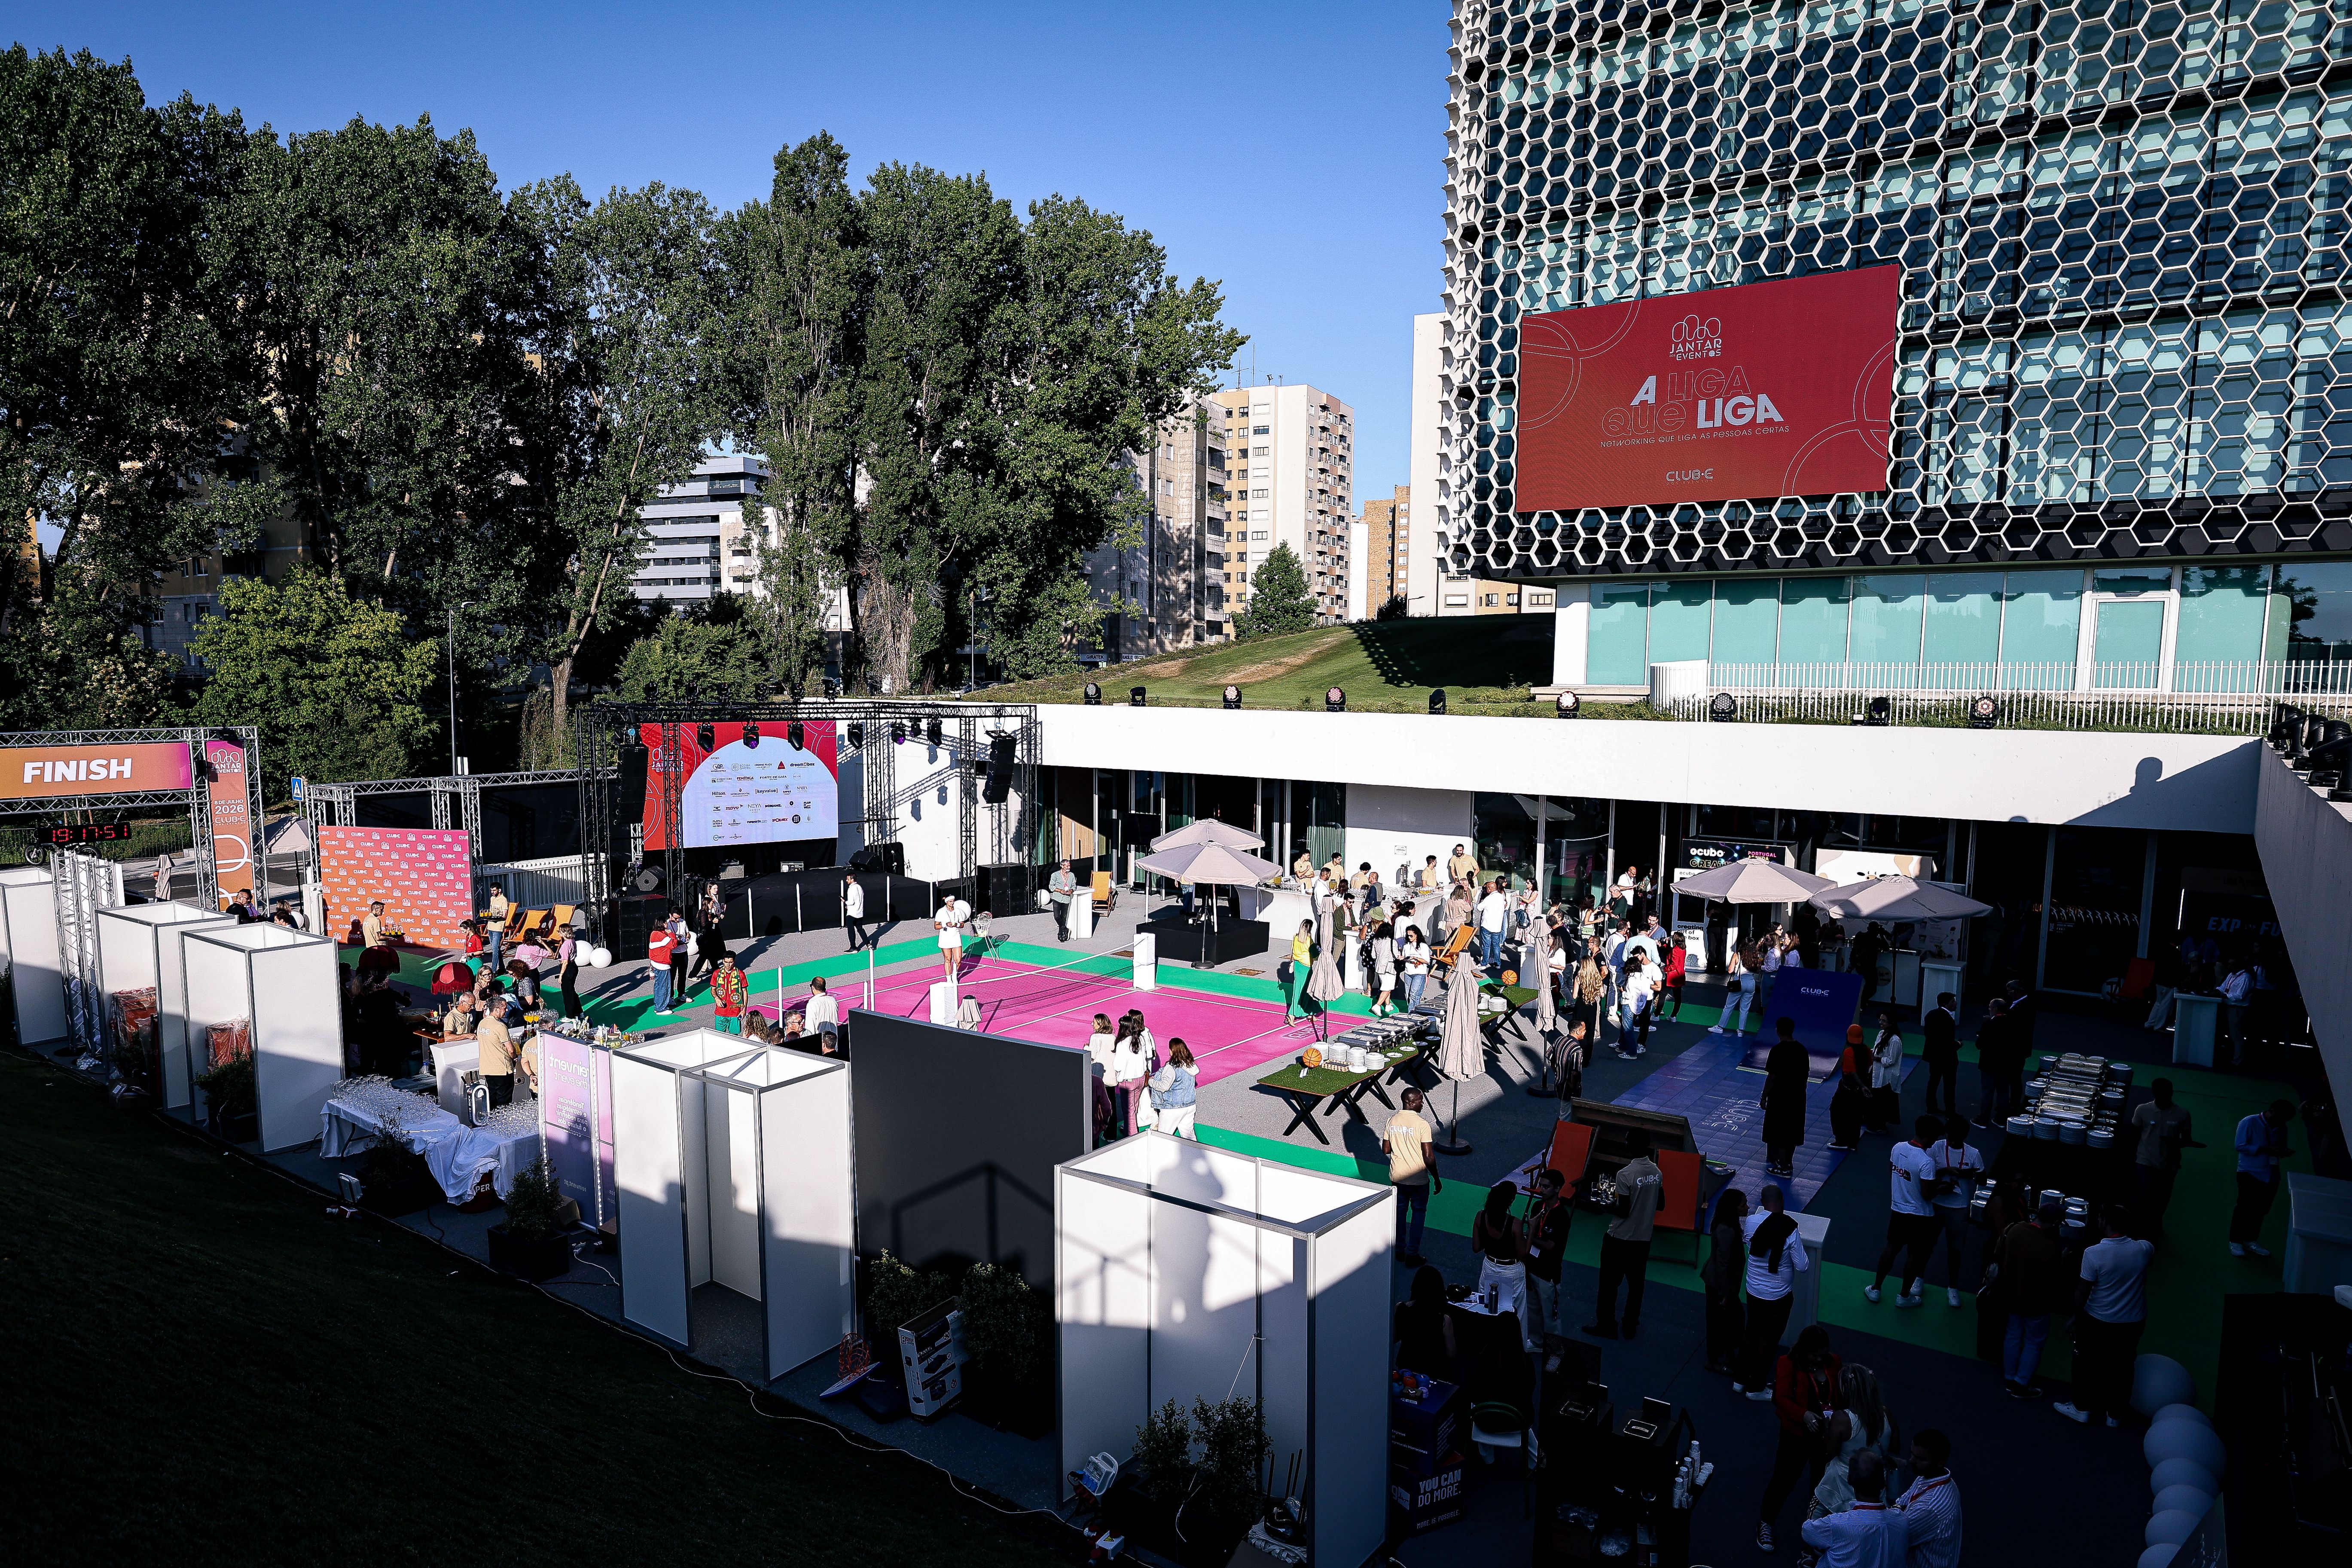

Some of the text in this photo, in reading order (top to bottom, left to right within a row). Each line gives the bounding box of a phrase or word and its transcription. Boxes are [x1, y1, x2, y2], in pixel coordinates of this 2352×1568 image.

[1669, 339, 1722, 354] JANTAR
[1676, 349, 1721, 360] EVENTOS
[1630, 366, 1751, 406] A LIGA
[1697, 394, 1784, 429] LIGA
[23, 758, 132, 784] FINISH
[215, 805, 244, 814] 2026
[1690, 848, 1724, 857] ocubo
[2207, 916, 2242, 933] EXP
[1419, 1476, 1439, 1494] YOU
[1440, 1469, 1461, 1487] CAN
[1418, 1492, 1431, 1507] DO
[1434, 1483, 1461, 1502] MORE.
[1417, 1519, 1431, 1529] MORE.
[1438, 1509, 1460, 1522] POSSIBLE.
